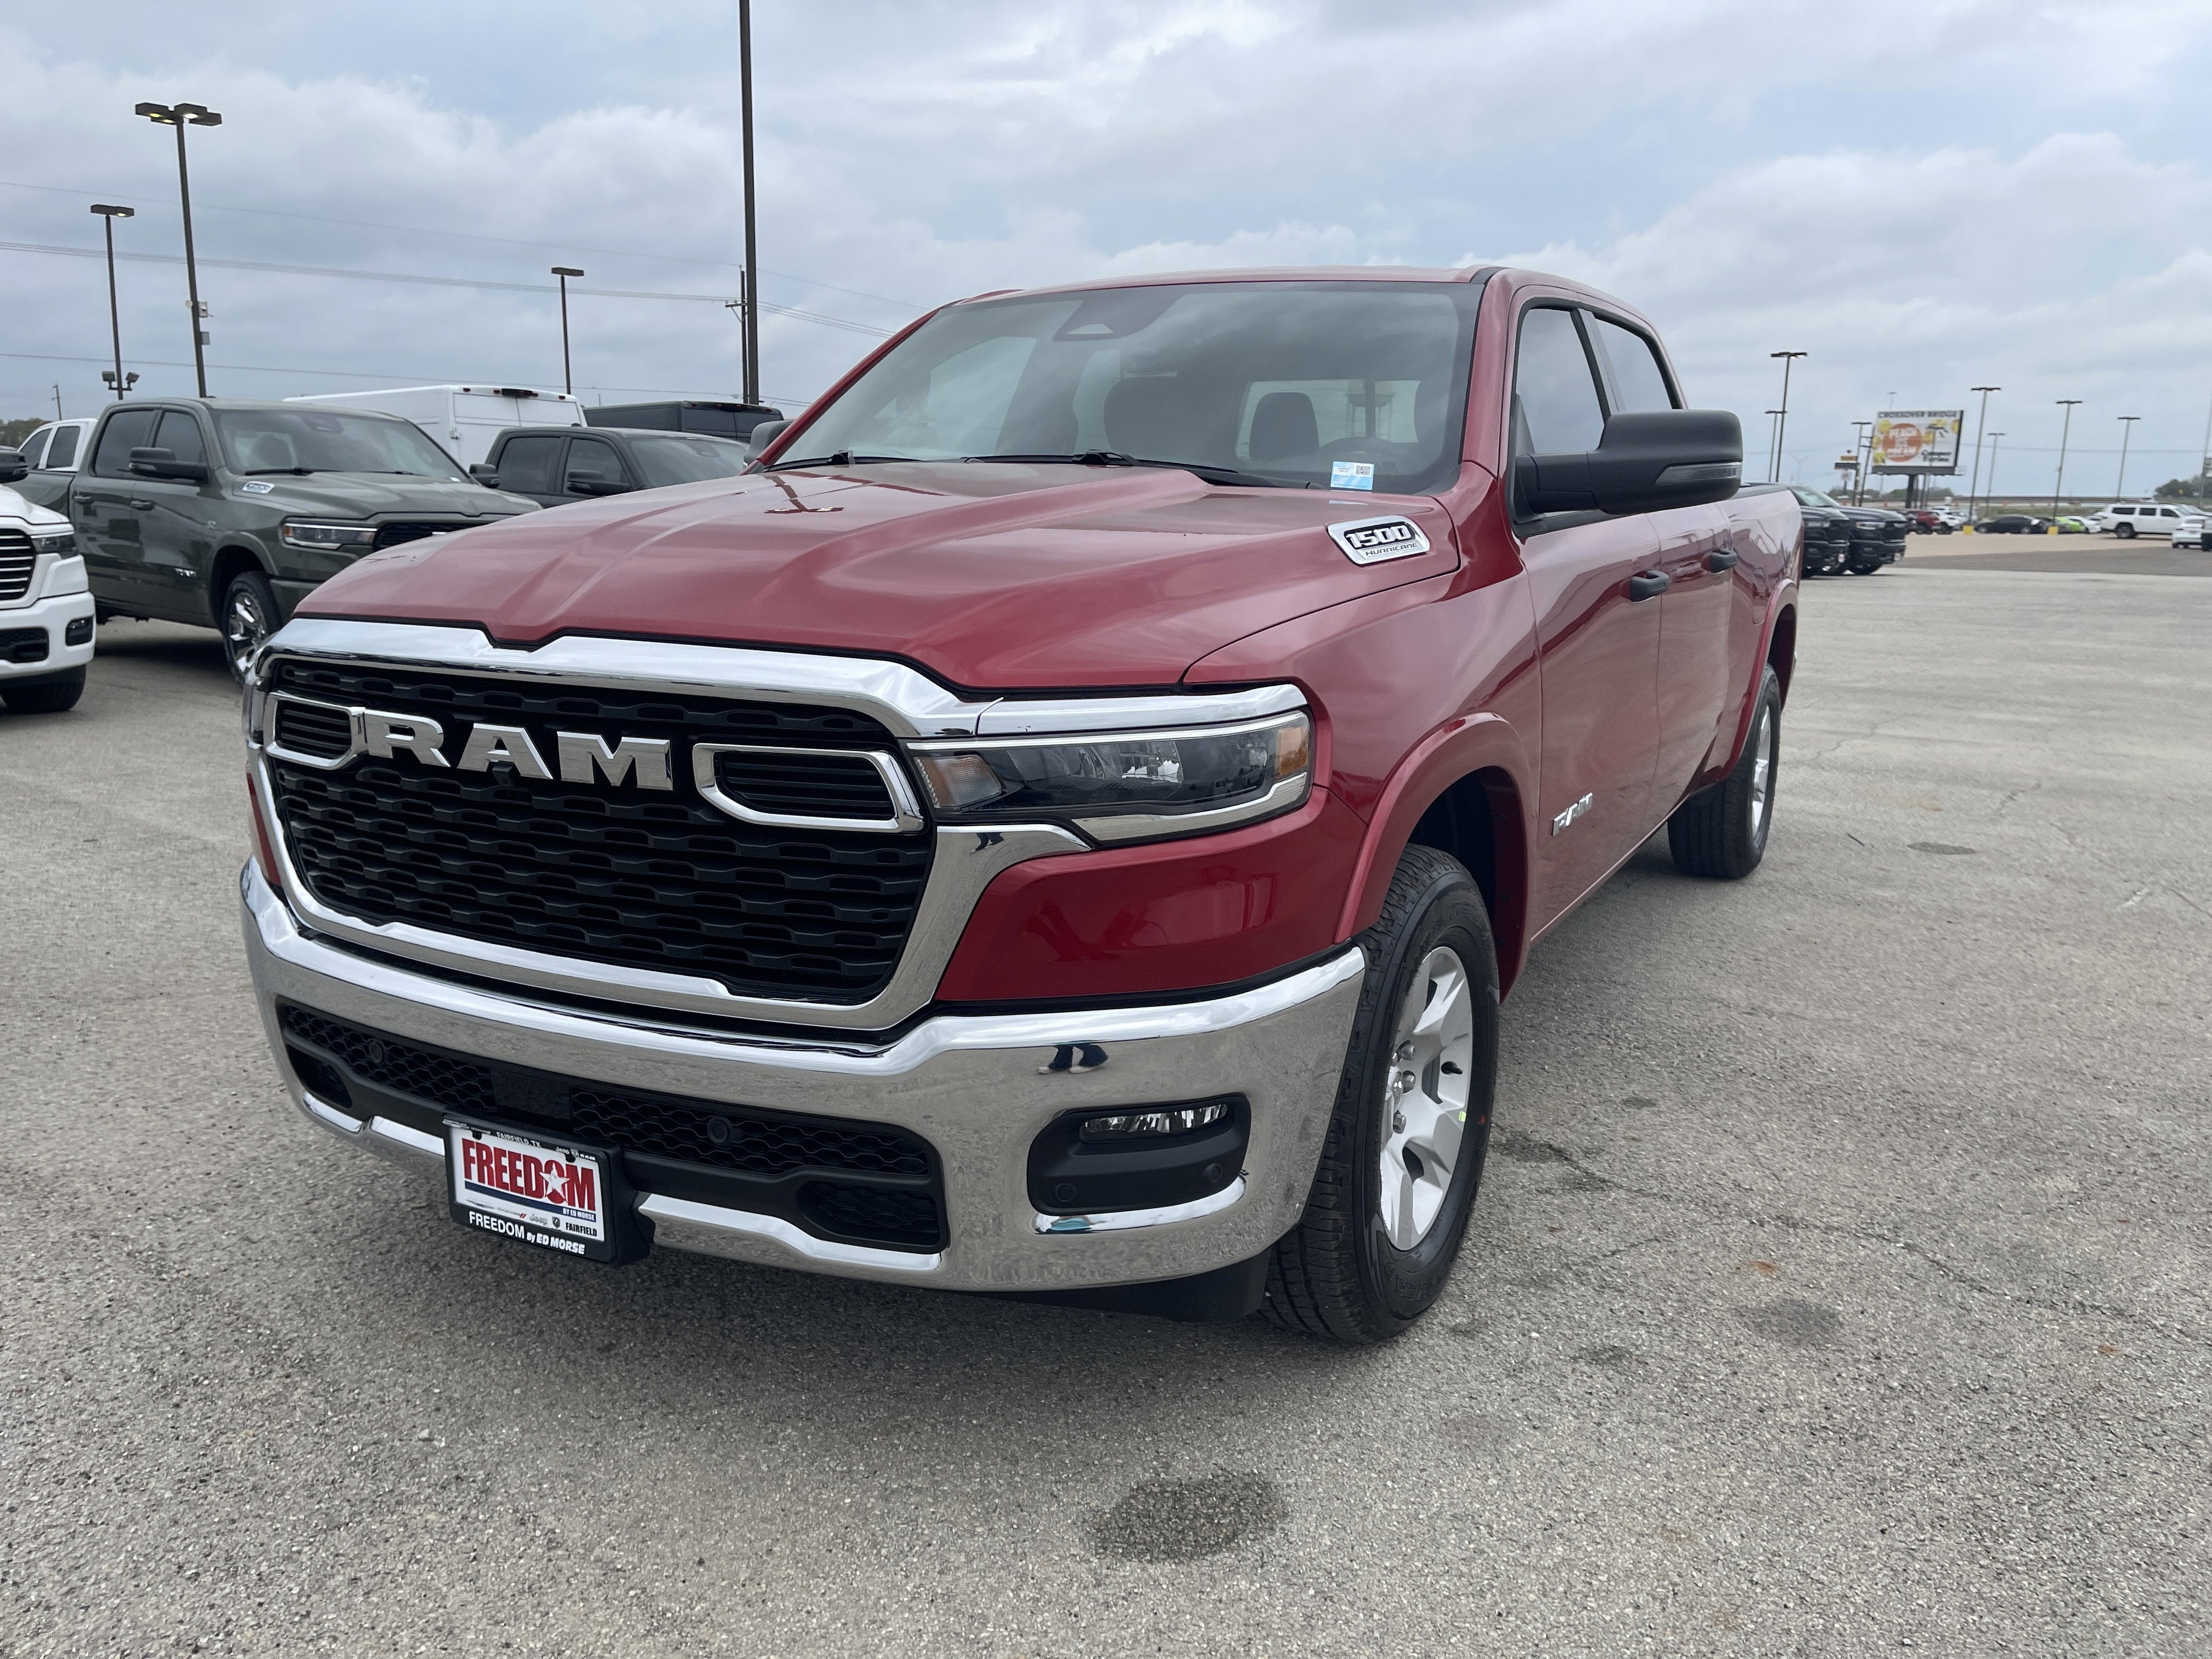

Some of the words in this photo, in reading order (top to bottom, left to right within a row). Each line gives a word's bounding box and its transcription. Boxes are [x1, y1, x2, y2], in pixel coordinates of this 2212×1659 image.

[1346, 524, 1412, 549] 1500
[1365, 542, 1419, 556] HURRICANE
[363, 708, 674, 791] RAM
[461, 1137, 596, 1212] FREEDOM
[577, 1211, 595, 1221] MORSE
[469, 1211, 525, 1240] FREEDOM
[536, 1233, 549, 1245] ED
[550, 1236, 585, 1255] MORSE
[566, 1222, 597, 1237] FAIRFIELD
